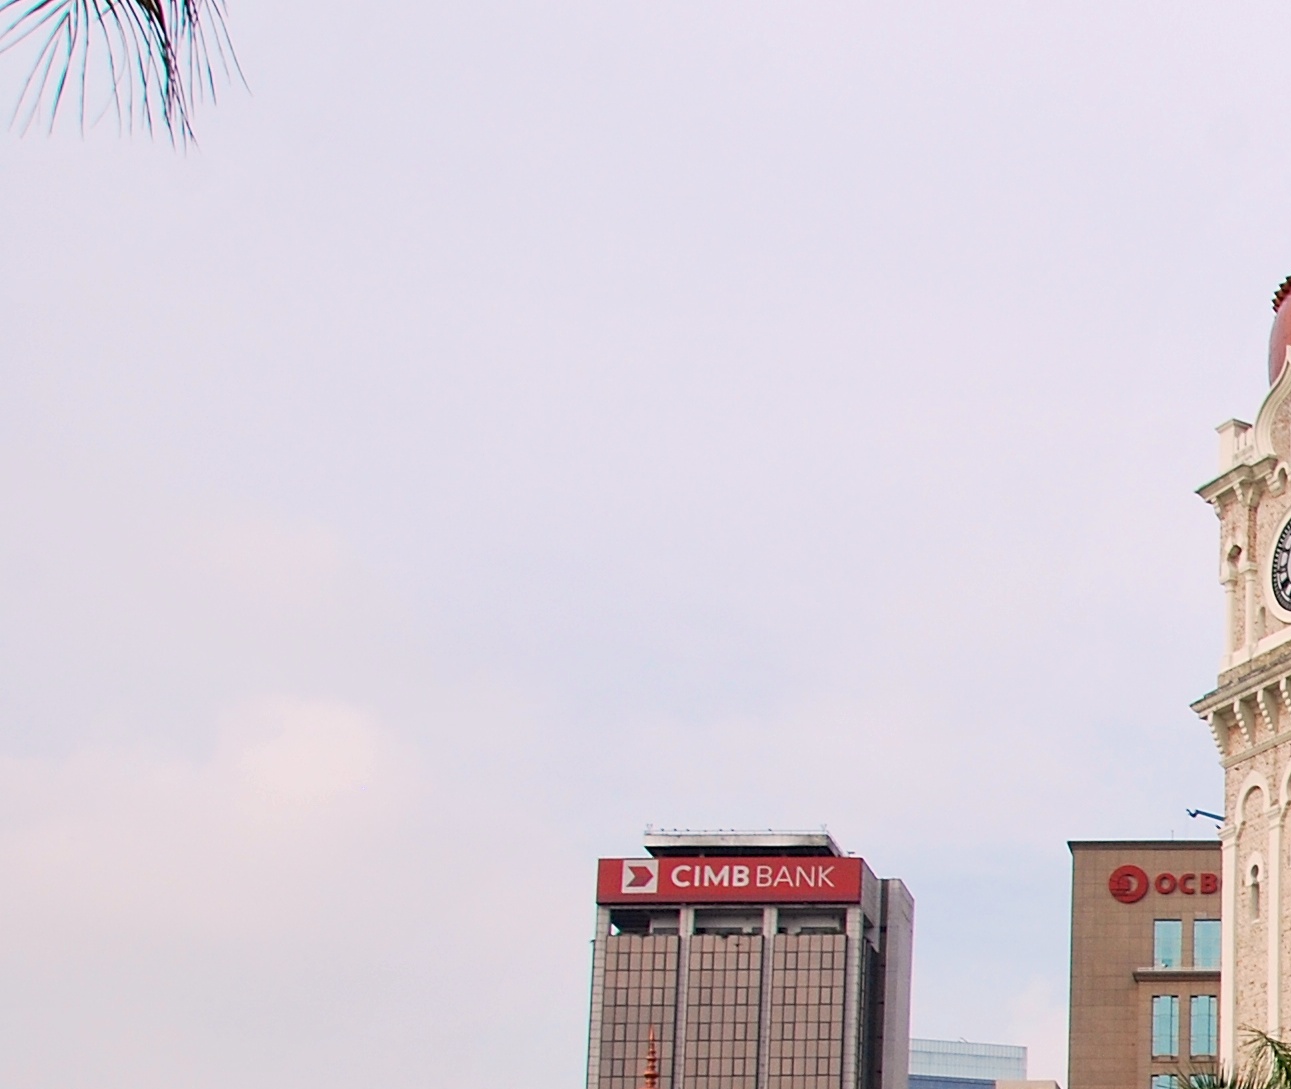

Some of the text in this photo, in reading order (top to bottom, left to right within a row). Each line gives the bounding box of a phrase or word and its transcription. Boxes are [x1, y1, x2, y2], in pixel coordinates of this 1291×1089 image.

[671, 864, 836, 888] CIMB BANK
[1155, 873, 1222, 895] OCB
